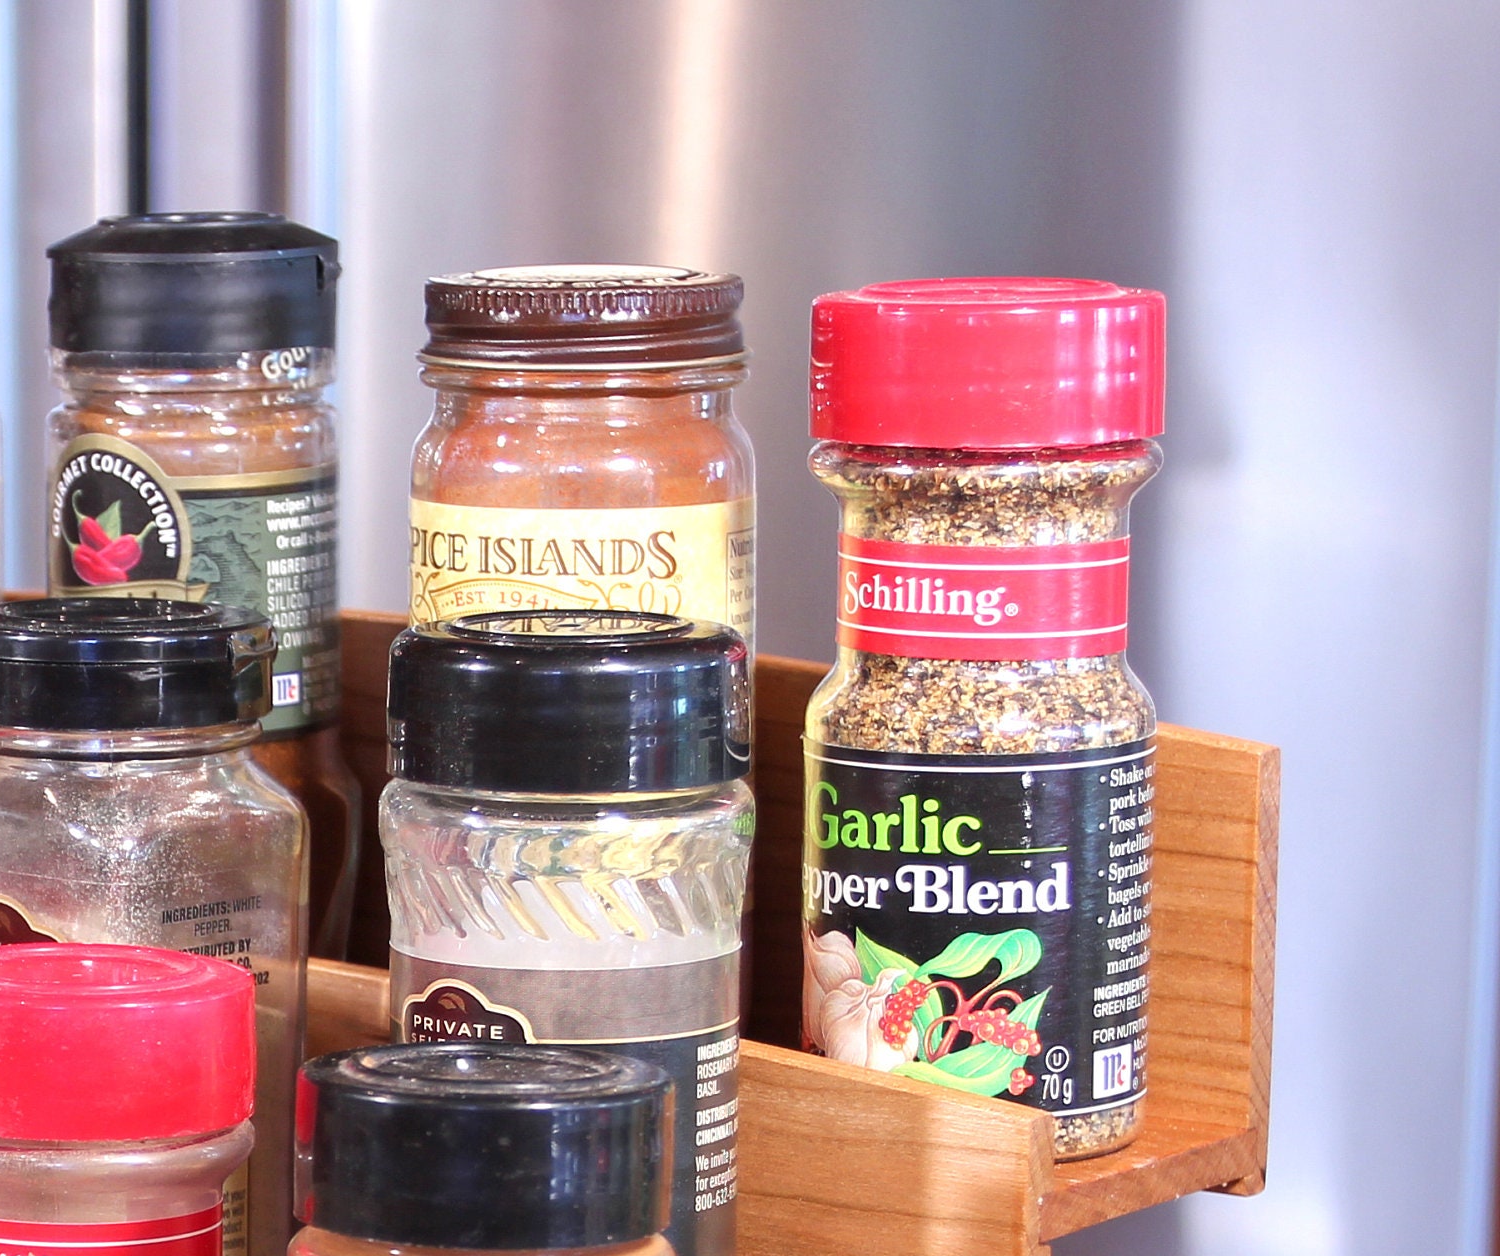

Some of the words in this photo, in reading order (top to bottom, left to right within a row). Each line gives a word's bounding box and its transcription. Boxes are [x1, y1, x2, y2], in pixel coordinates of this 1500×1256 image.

[52, 454, 88, 537] GOURMET
[410, 526, 468, 573] PICE
[478, 530, 678, 580] ISLANDS
[267, 575, 300, 594] CHILE
[455, 590, 485, 607] EST
[1110, 764, 1144, 787] Shake
[1109, 788, 1137, 815] pork
[809, 781, 983, 857] Garlic
[1109, 815, 1136, 834] Toss
[802, 868, 890, 915] epper
[895, 861, 1071, 915] Blend
[1108, 881, 1141, 906] bagels
[162, 901, 231, 924] INGREDIENTS:
[233, 896, 261, 913] WHITE
[1107, 905, 1132, 929] Add
[1134, 906, 1142, 922] to
[238, 938, 251, 953] BY
[1093, 998, 1125, 1018] GREEN
[412, 1014, 504, 1041] PRIVATE
[1092, 1027, 1115, 1044] FOR
[695, 1154, 709, 1172] We
[695, 1176, 709, 1192] for
